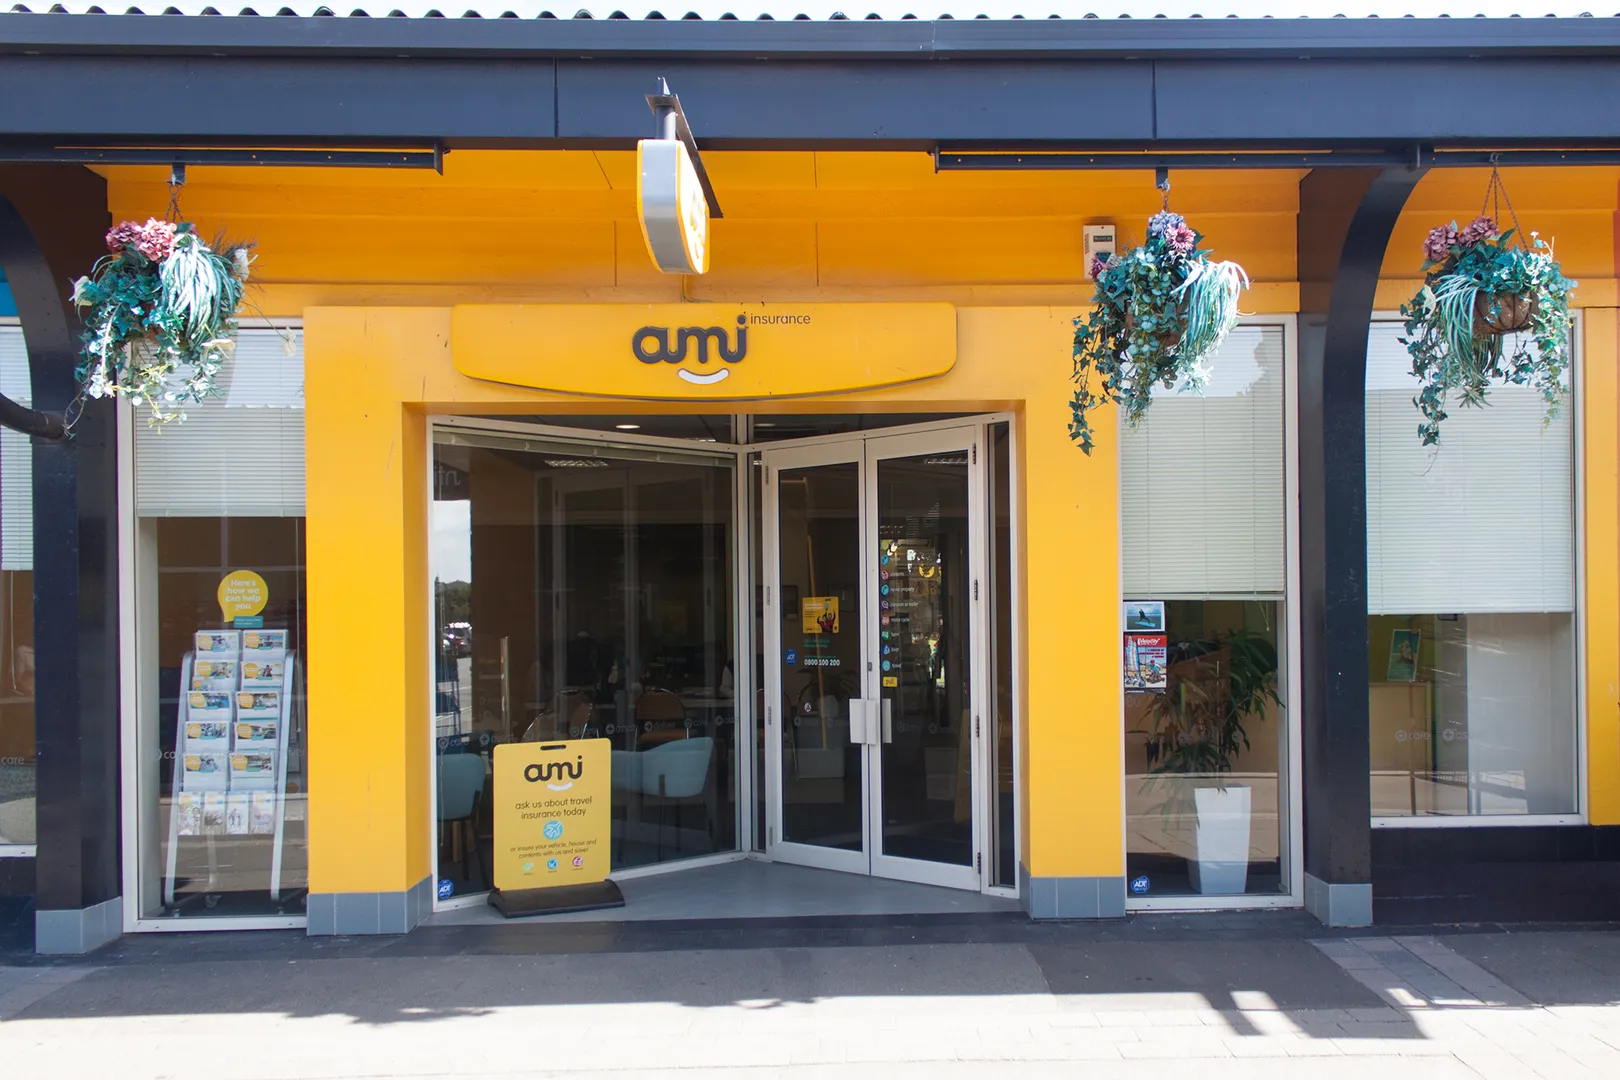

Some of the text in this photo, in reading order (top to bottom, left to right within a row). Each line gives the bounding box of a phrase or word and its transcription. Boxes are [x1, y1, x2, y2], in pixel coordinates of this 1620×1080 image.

[750, 313, 811, 325] insurance
[632, 314, 749, 364] ami
[230, 579, 257, 587] Here's
[242, 594, 261, 603] help
[235, 603, 252, 611] you
[1408, 731, 1430, 740] care
[1, 756, 25, 765] care
[524, 755, 583, 782] ami
[515, 800, 530, 810] ask
[543, 798, 568, 808] about
[570, 796, 593, 805] travel
[521, 807, 587, 819] insurance today
[1134, 880, 1147, 888] ADT
